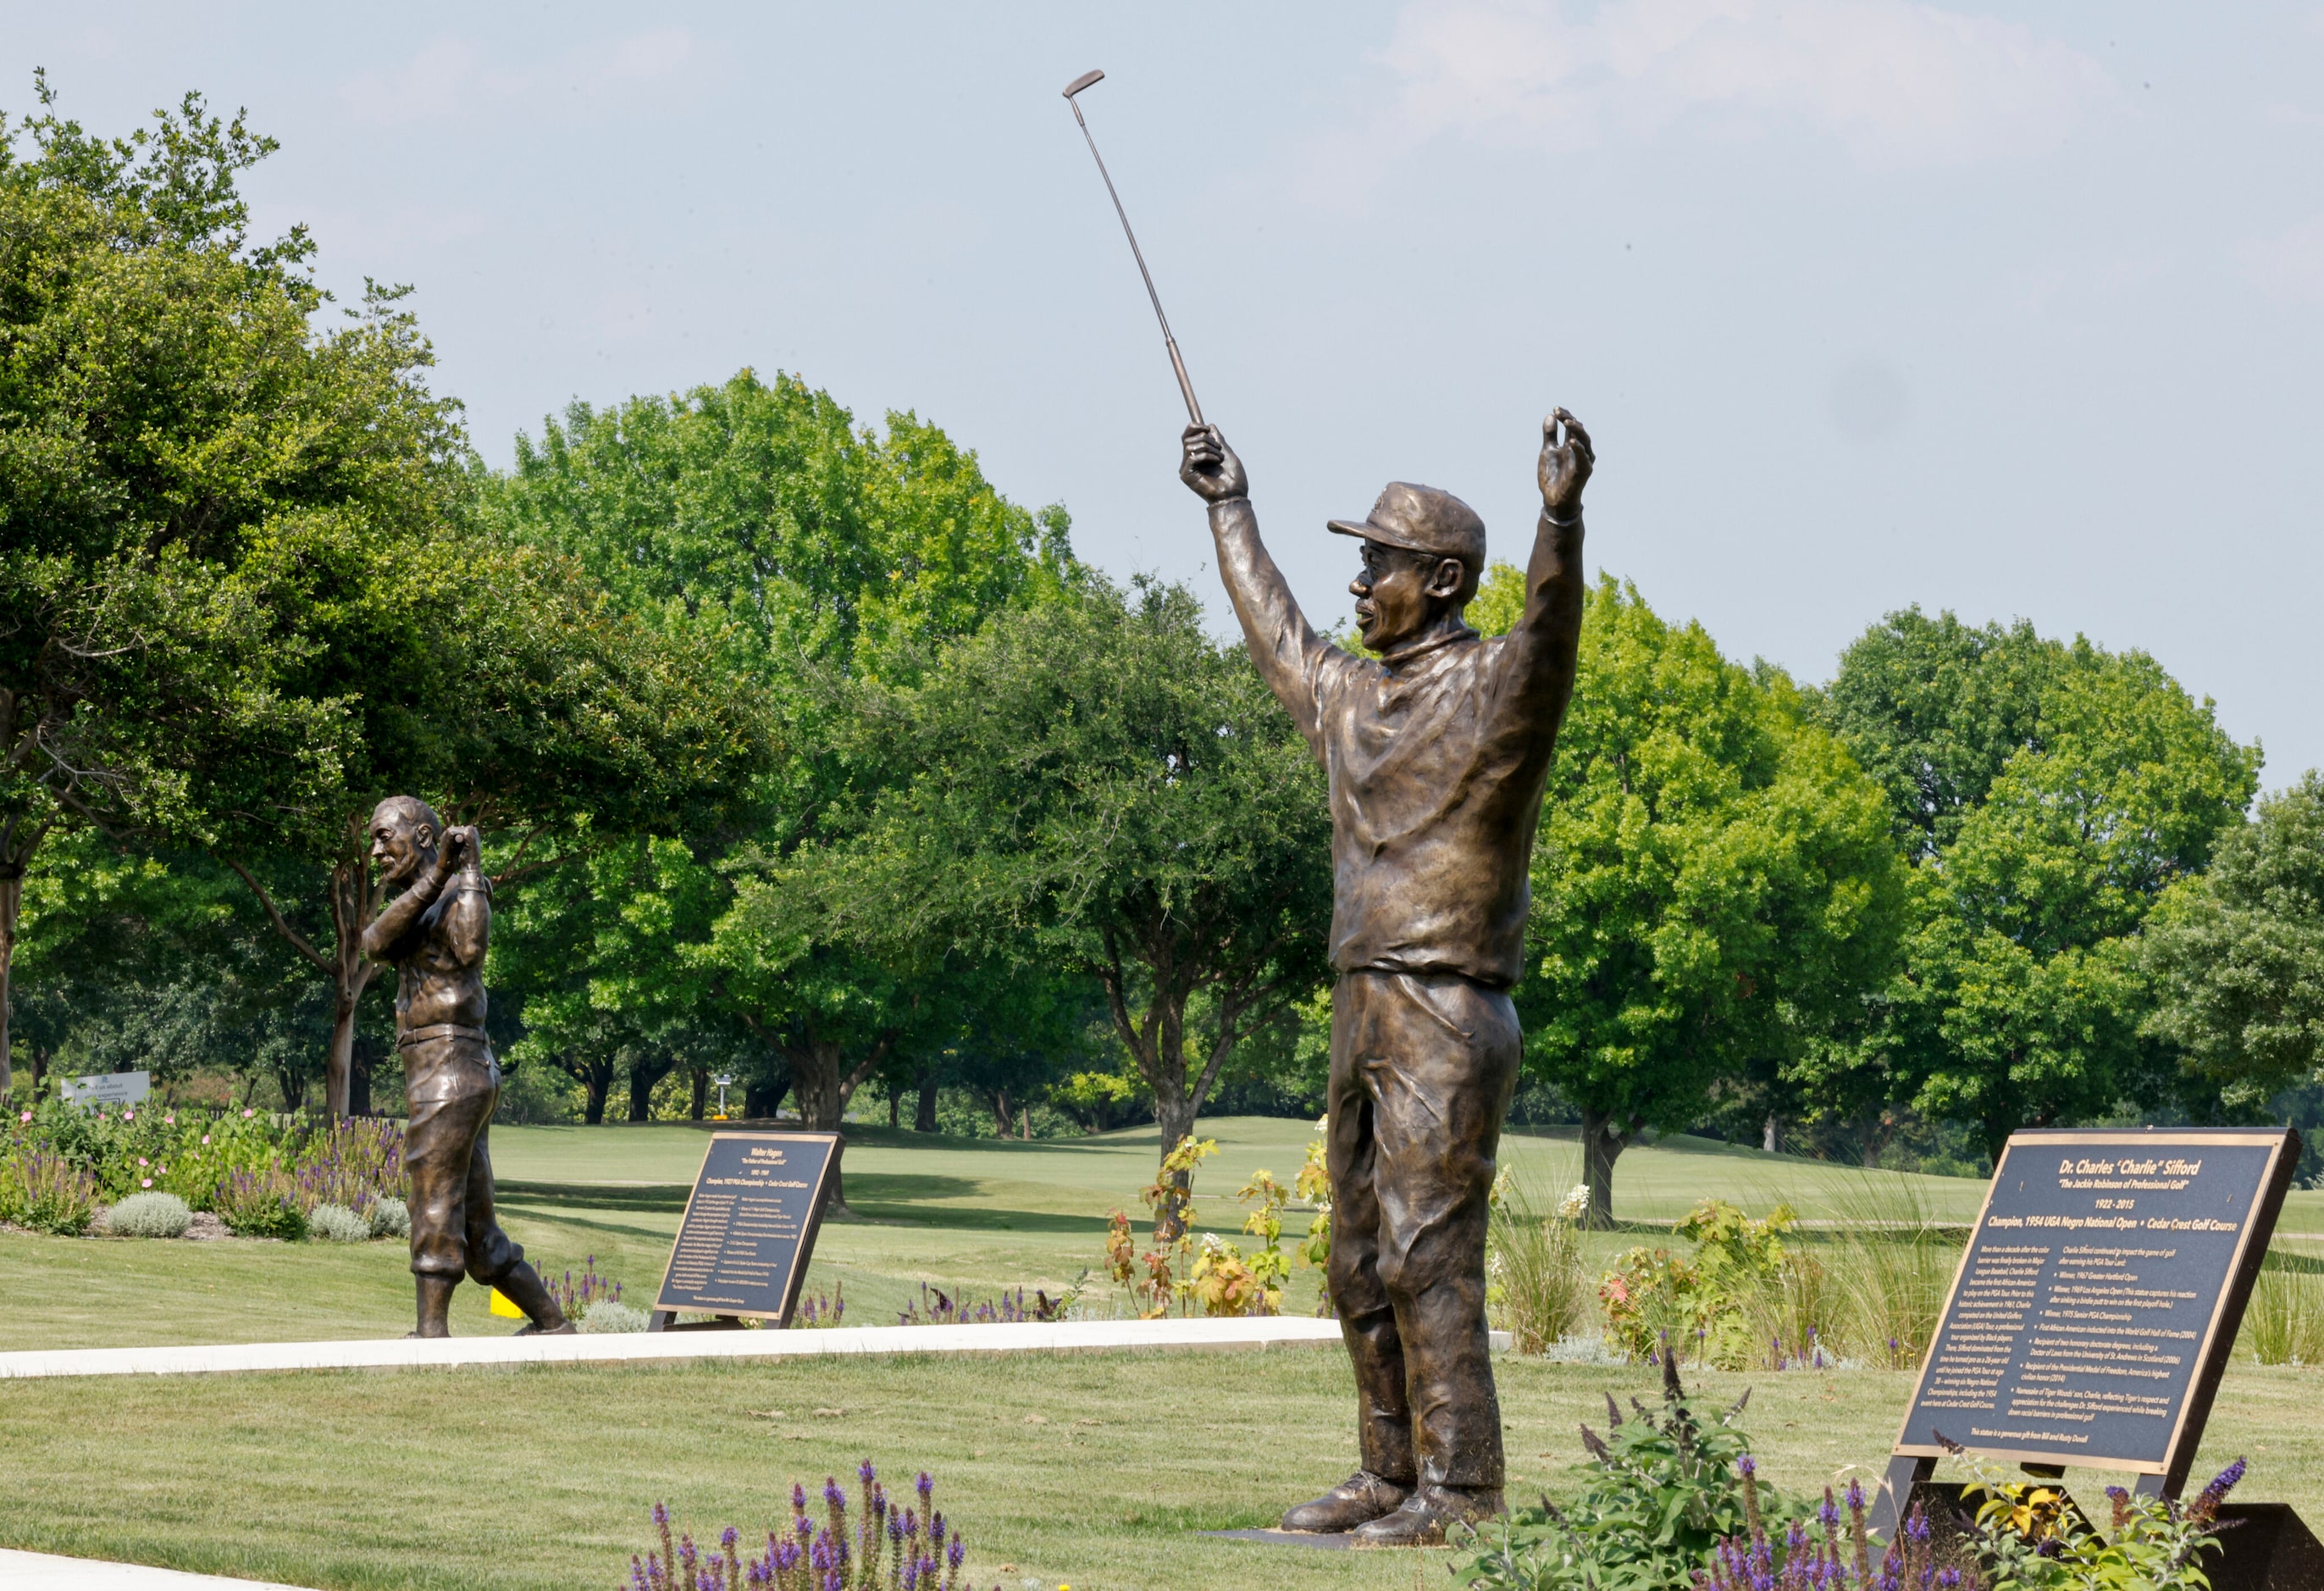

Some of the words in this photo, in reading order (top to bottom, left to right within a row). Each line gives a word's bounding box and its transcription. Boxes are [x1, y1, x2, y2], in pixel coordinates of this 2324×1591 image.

[766, 1149, 783, 1158] Hagen
[2059, 1160, 2074, 1174] Dr.
[2076, 1159, 2115, 1174] Charles
[2116, 1159, 2165, 1175] “Charlie”
[2162, 1159, 2201, 1175] Sifford
[2059, 1179, 2073, 1188] “The
[2072, 1179, 2094, 1189] Jackie
[2093, 1179, 2123, 1189] Robinson
[2122, 1179, 2132, 1189] of
[2130, 1179, 2172, 1189] Professional
[2170, 1180, 2189, 1189] Golf”
[2095, 1199, 2113, 1209] 1922
[2115, 1199, 2135, 1210] 2015
[1988, 1216, 2023, 1228] Champion,
[2025, 1216, 2045, 1227] 1954
[2044, 1216, 2061, 1227] UGA
[2060, 1217, 2084, 1229] Negro
[2083, 1217, 2118, 1228] National
[2116, 1217, 2138, 1231] Open
[2147, 1218, 2171, 1229] Cedar
[2170, 1218, 2192, 1231] Crest
[2191, 1219, 2211, 1230] Golf
[2209, 1219, 2238, 1231] Course
